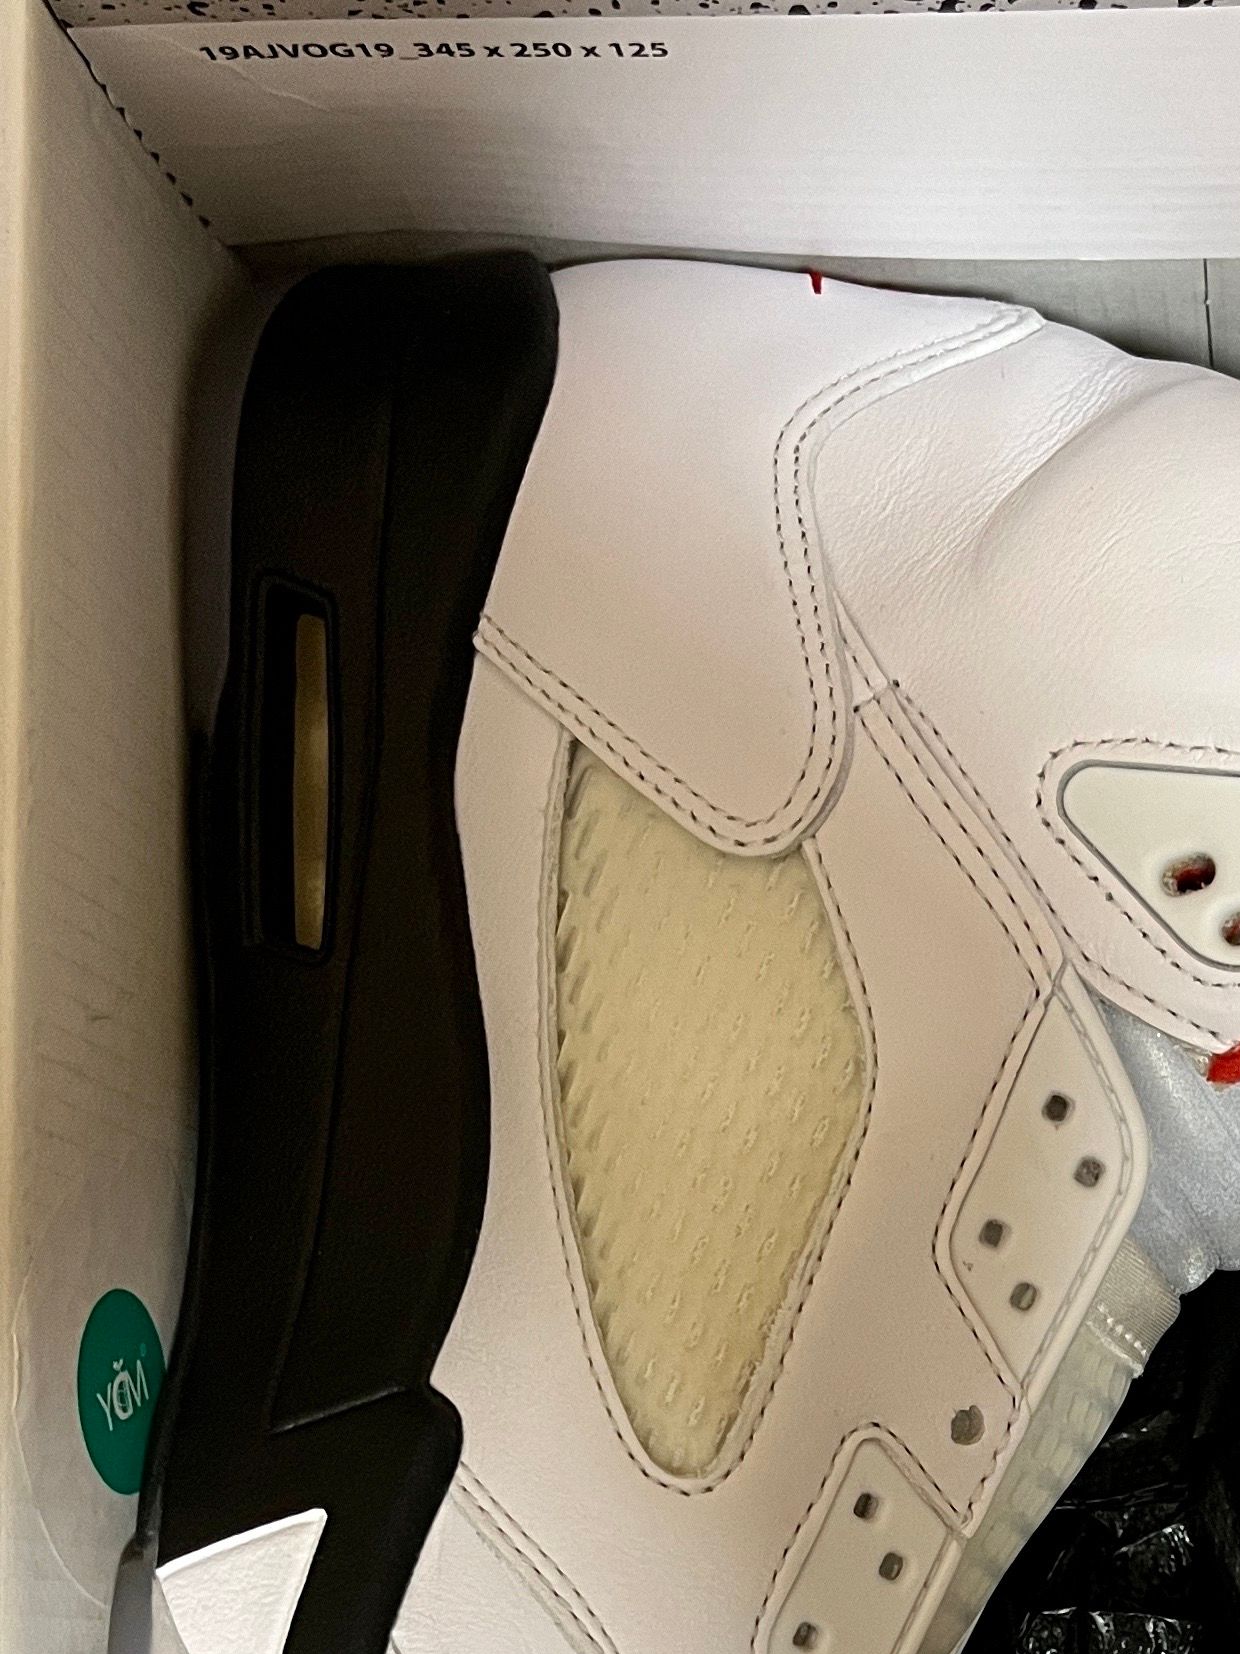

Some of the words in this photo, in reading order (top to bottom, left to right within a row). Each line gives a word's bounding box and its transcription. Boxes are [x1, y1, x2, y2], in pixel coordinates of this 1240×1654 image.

[482, 45, 505, 58] x
[509, 42, 572, 58] 250
[579, 45, 602, 58] x
[607, 42, 669, 58] 125
